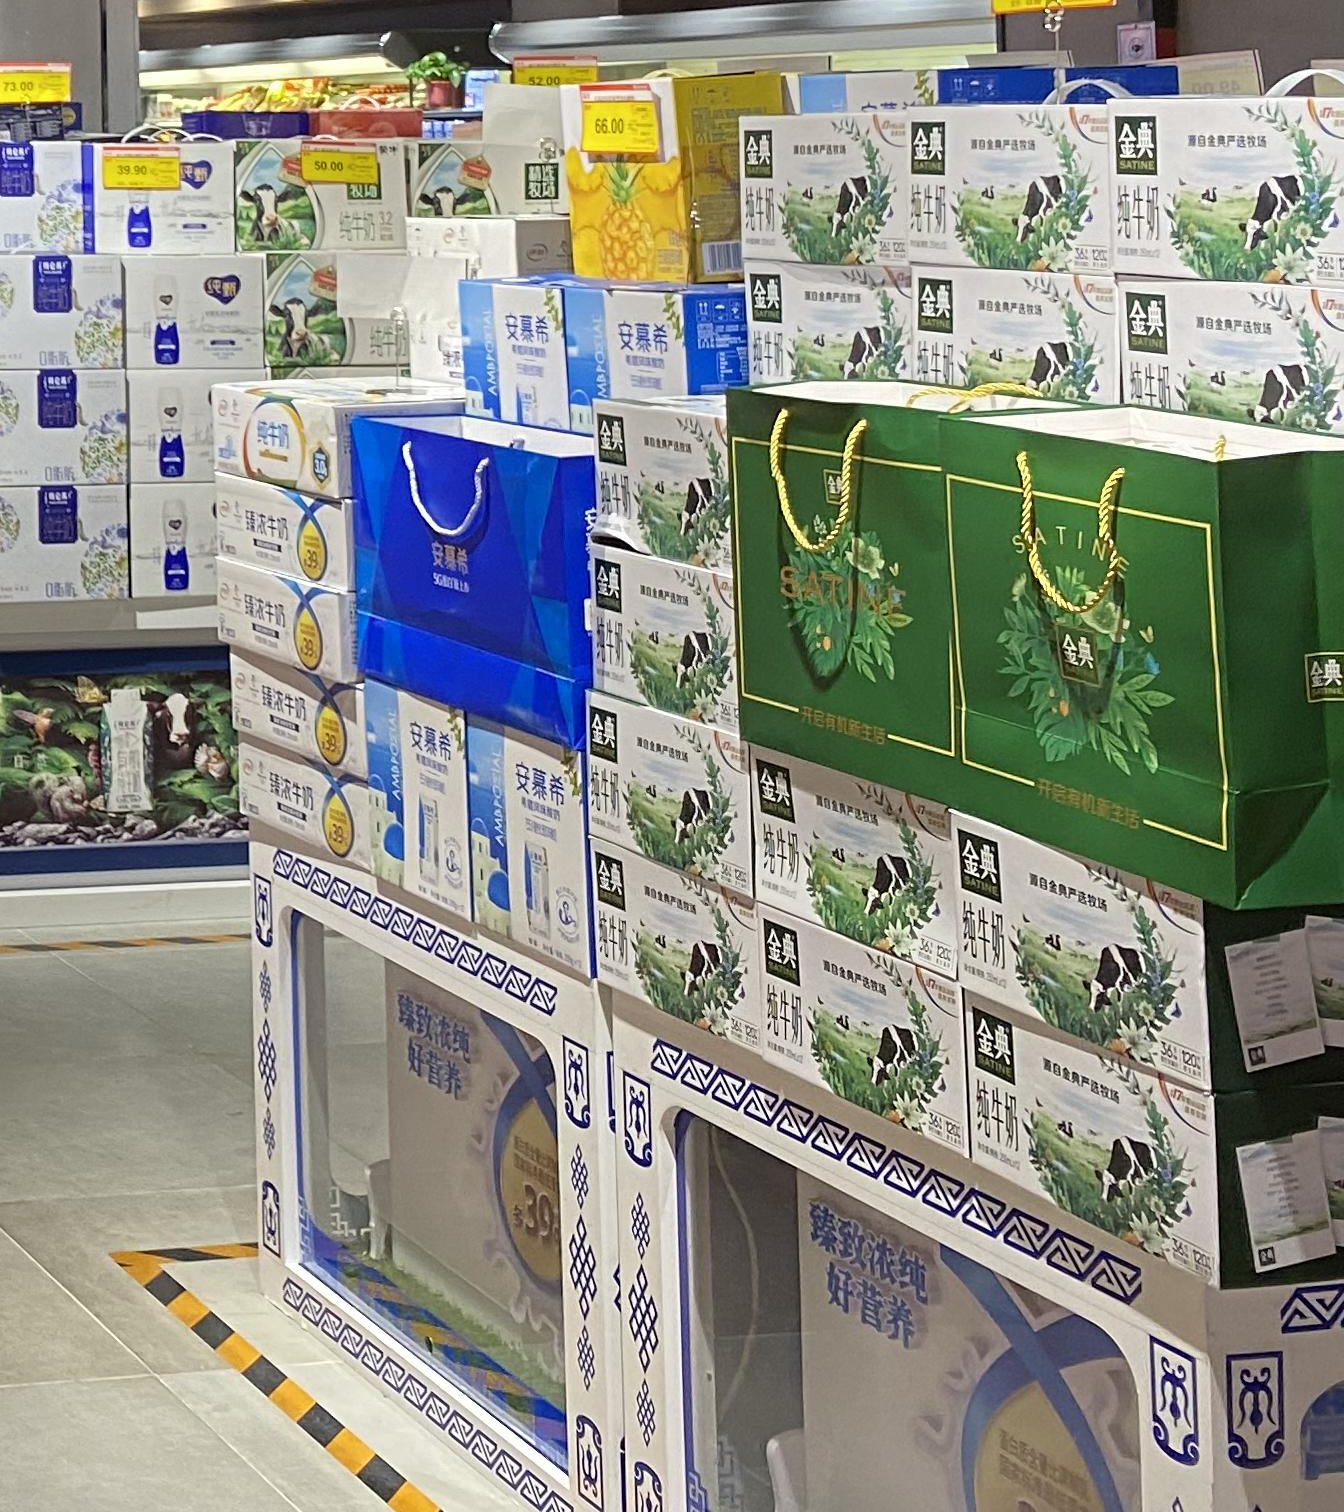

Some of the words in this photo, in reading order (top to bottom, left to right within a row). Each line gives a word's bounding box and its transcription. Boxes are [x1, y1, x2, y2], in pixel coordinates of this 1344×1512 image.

[3, 81, 35, 93] 73.00
[528, 76, 561, 86] 52.00
[594, 118, 625, 135] 66.00
[913, 126, 943, 161] 金典
[970, 139, 1036, 151] 源自金典严选牧场
[1118, 122, 1154, 159] 金典
[1187, 135, 1267, 148] 源自金典严选牧场
[314, 160, 345, 173] 50.00
[746, 134, 770, 165] 金典
[1119, 160, 1155, 170] SATINE
[116, 165, 148, 176] 39.90
[745, 186, 775, 232] 纯牛奶
[911, 184, 946, 233] 纯牛奶
[1117, 185, 1159, 240] 纯牛奶
[753, 279, 779, 310] 金典
[920, 284, 950, 319] 金典
[978, 299, 1043, 316] 源自金典严选牧场
[505, 312, 549, 345] 安慕希
[617, 319, 668, 354] 安慕希
[1129, 300, 1164, 337] 金典
[1196, 316, 1272, 336] 源自金典严选牧场
[753, 330, 784, 376] 纯牛奶
[917, 341, 954, 386] 纯牛奶
[1130, 361, 1171, 409] 纯牛奶
[600, 419, 623, 452] 金典
[244, 508, 289, 542] 臻浓牛奶
[431, 540, 469, 575] 安慕希
[1013, 525, 1129, 579] SATINE
[596, 564, 620, 599] 金典
[779, 565, 906, 614] SATINE
[243, 593, 287, 630] 臻浓牛奶
[596, 615, 624, 668] 纯牛奶
[1062, 633, 1094, 669] 金典
[1310, 658, 1344, 688] 金典
[261, 683, 307, 723] 臻浓牛奶
[409, 720, 452, 762] 安慕希
[591, 713, 615, 749] 金典
[269, 771, 314, 812] 臻浓牛奶
[515, 760, 565, 807] 安慕希
[590, 763, 620, 819] 纯牛奶
[760, 767, 790, 807] 金典
[815, 794, 879, 827] 源自金典严选牧场
[1037, 778, 1140, 830] 开启有机新生活
[763, 823, 800, 883] 纯牛奶
[962, 838, 997, 885] 金典
[598, 859, 622, 895] 金典
[1029, 872, 1108, 913] 源自金典严选牧场
[599, 910, 628, 967] 纯牛奶
[766, 927, 797, 970] 金典
[962, 900, 1005, 970] 纯牛奶
[823, 959, 887, 997] 源自金典严选牧场
[397, 993, 471, 1064] 臻致浓纯
[766, 983, 803, 1047] 纯牛奶
[975, 1016, 1012, 1066] 金典
[407, 1037, 462, 1100] 好营养
[1042, 1056, 1120, 1105] 源自金典严选牧场
[976, 1079, 1020, 1153] 纯牛奶
[809, 1199, 929, 1306] 臻致浓纯
[826, 1260, 915, 1349] 好营养
